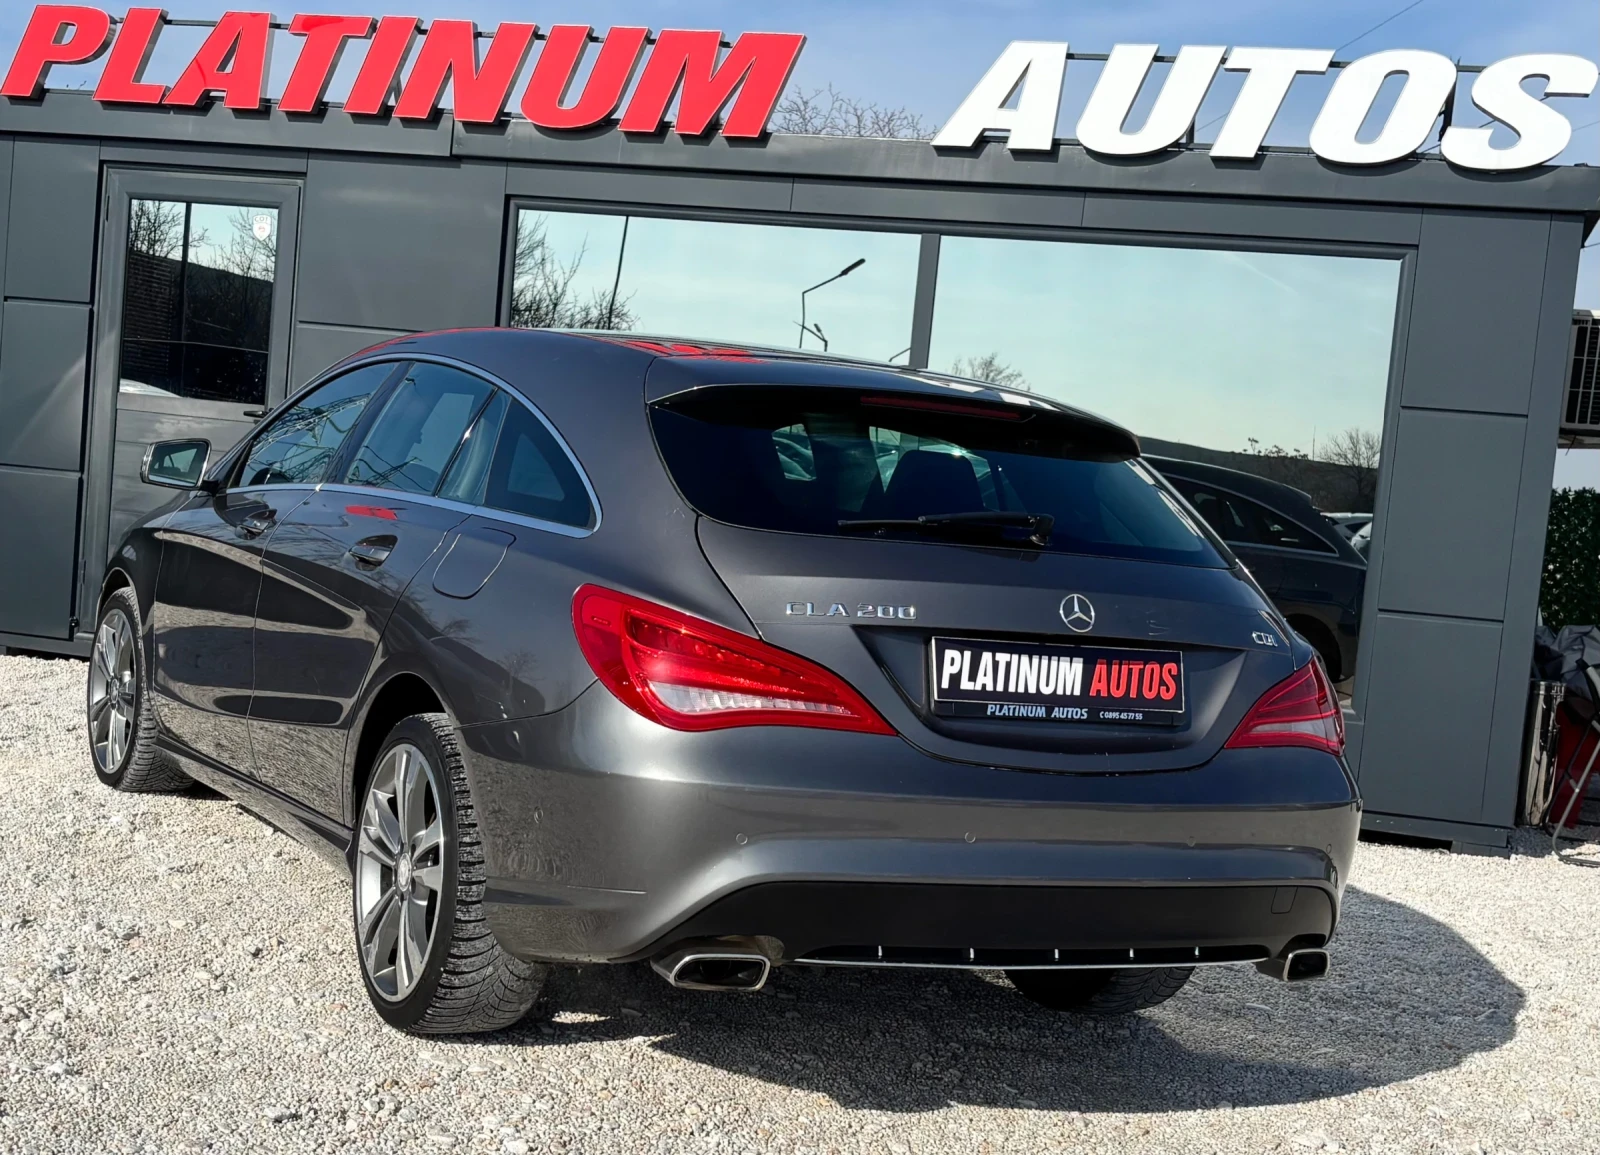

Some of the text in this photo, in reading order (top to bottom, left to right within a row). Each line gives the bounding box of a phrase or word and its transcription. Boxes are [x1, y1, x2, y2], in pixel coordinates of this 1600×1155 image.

[0, 5, 1599, 170] PLATINUM AUTOS
[786, 602, 917, 619] CLA 200
[1252, 631, 1278, 646] CDI
[941, 649, 1178, 700] PLATINUM AUTOS
[987, 704, 1046, 718] PLATINUM
[1050, 706, 1088, 719] AUTOS
